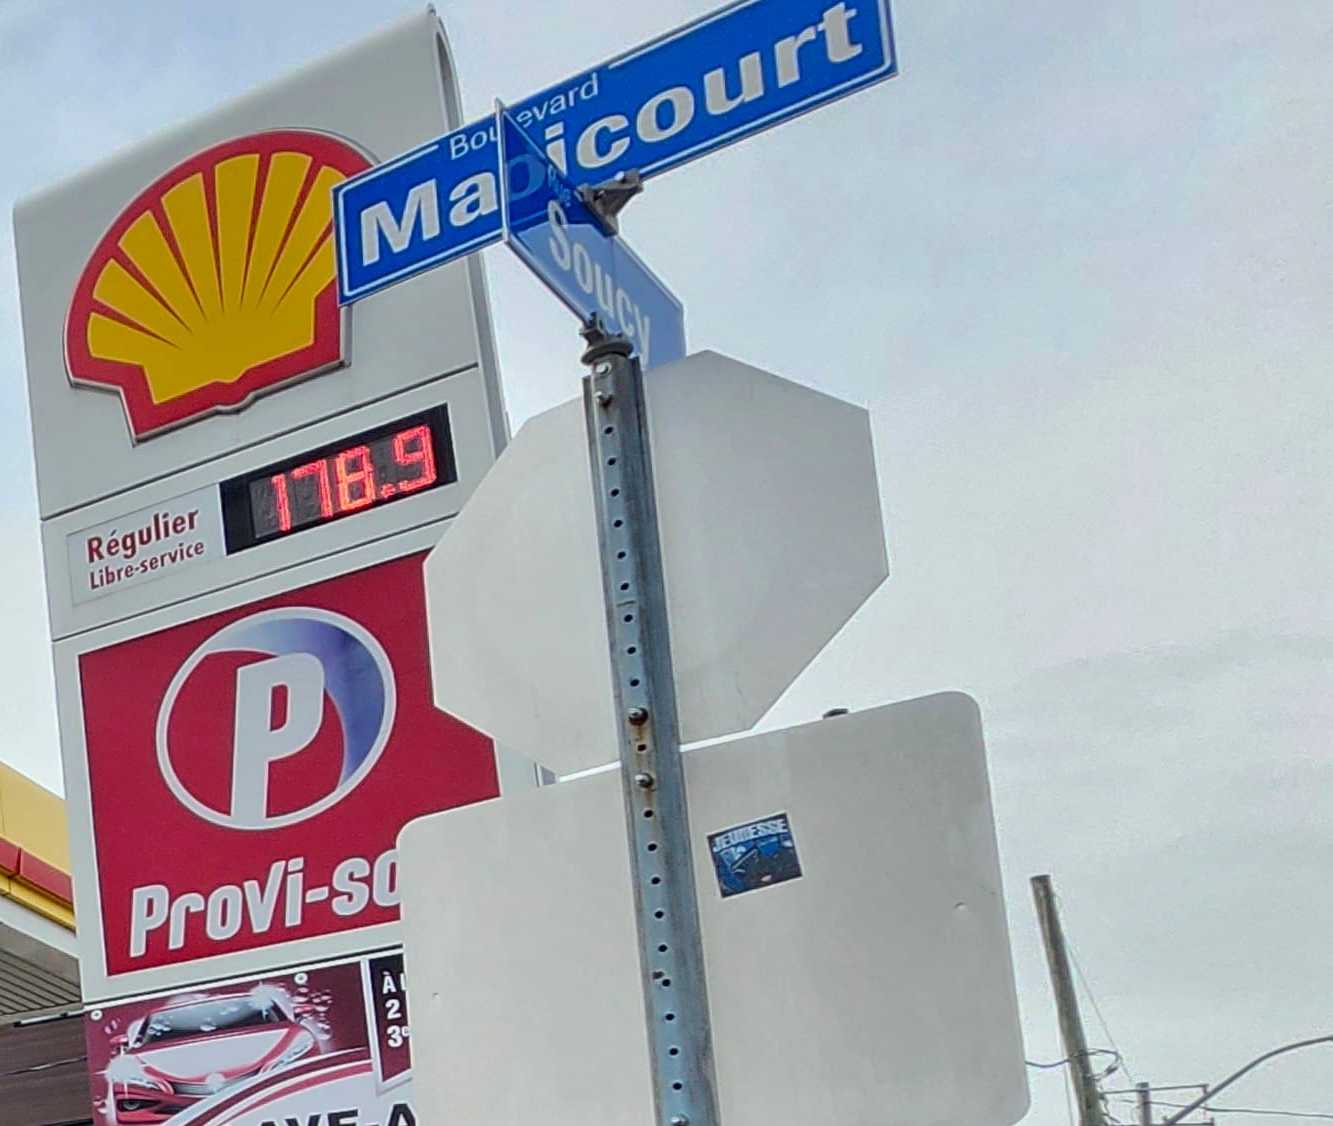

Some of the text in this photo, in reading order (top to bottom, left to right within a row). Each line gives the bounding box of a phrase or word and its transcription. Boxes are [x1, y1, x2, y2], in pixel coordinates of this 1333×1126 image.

[360, 6, 862, 267] Maicourt
[449, 75, 599, 160] Bouevard
[548, 200, 651, 373] Soucy
[270, 425, 437, 531] 178.9
[86, 508, 199, 563] Régulier
[89, 540, 204, 590] Libre-service
[385, 999, 402, 1019] 2
